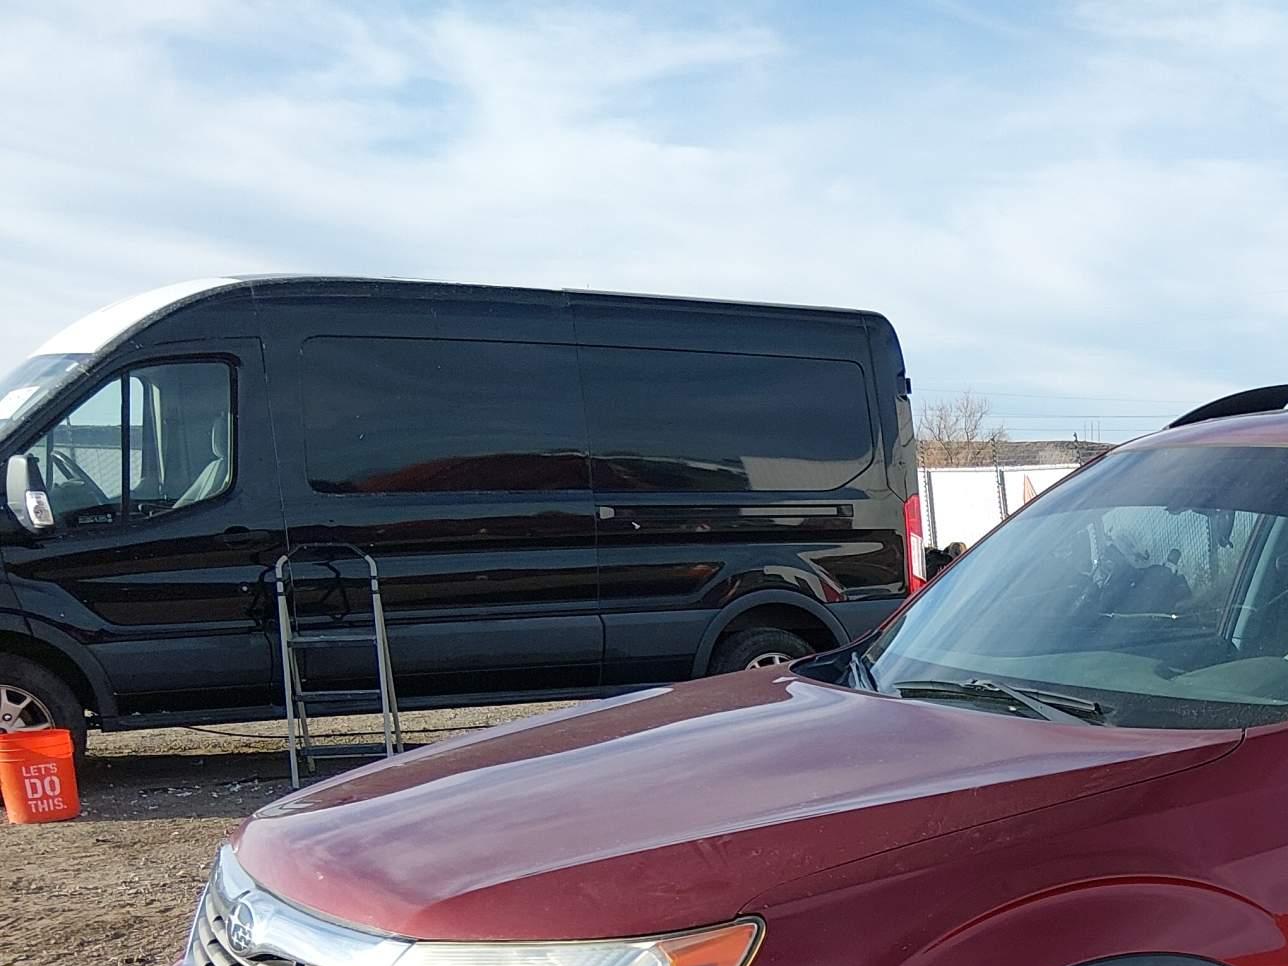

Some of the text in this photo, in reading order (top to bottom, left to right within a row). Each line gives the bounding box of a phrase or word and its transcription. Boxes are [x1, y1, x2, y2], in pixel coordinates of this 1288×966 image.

[21, 762, 58, 777] LET'S
[24, 775, 61, 799] DO
[27, 797, 68, 813] THIS.
